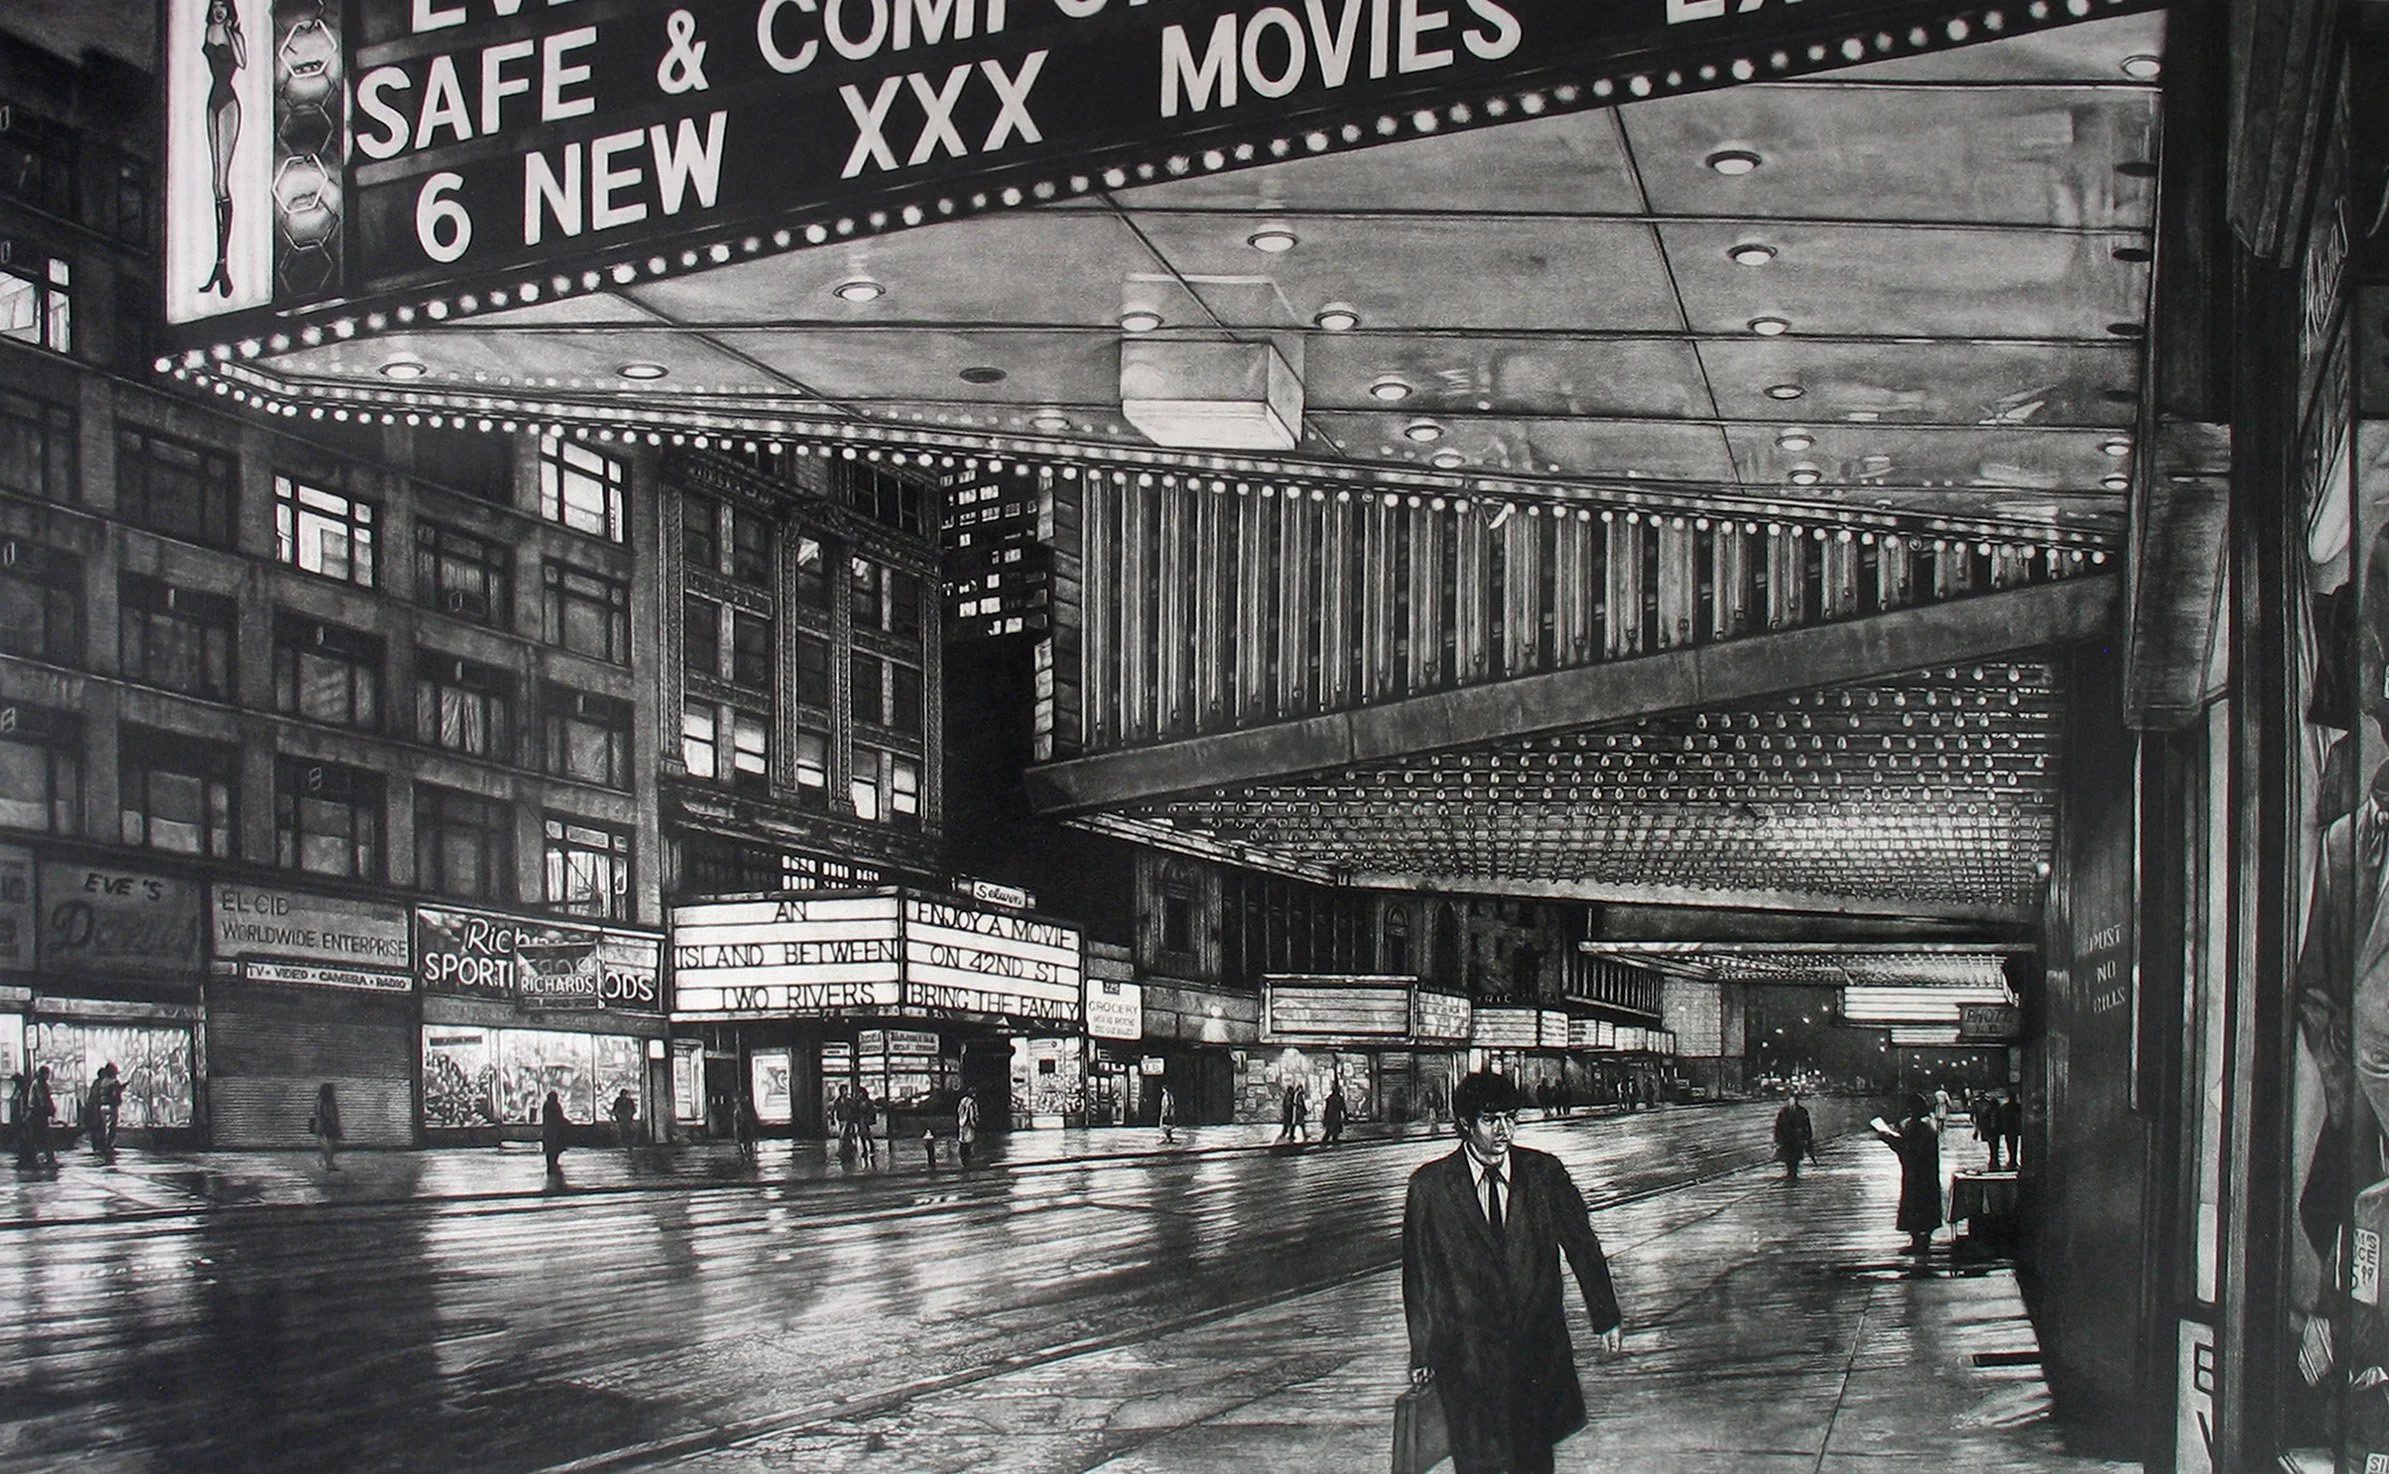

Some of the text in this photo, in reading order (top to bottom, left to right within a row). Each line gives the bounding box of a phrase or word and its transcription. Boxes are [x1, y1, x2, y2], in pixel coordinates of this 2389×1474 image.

[356, 26, 598, 160] SAFE
[657, 9, 709, 94] &
[416, 0, 1523, 263] 6 NEW XXX MOVIES
[222, 891, 291, 916] EL CID
[774, 901, 807, 922] AN
[918, 900, 1076, 951] ENJOY A MOVIE
[2089, 923, 2121, 952] POST
[322, 932, 407, 958] ENTERPRISE
[679, 939, 895, 969] ISLAND BETWEEN
[930, 945, 960, 968] ON
[970, 951, 1024, 978] 42ND
[2097, 960, 2116, 983] NO
[249, 965, 406, 989] TV VIDEO CAMERA RADIO
[521, 973, 595, 994] RICHARDS
[786, 983, 876, 1009] RIVERS
[911, 983, 970, 1010] BRING
[973, 990, 1014, 1012] THE
[1020, 996, 1080, 1021] FAMILY
[1088, 1000, 1139, 1016] GROCERY
[2093, 986, 2126, 1013] BILLS
